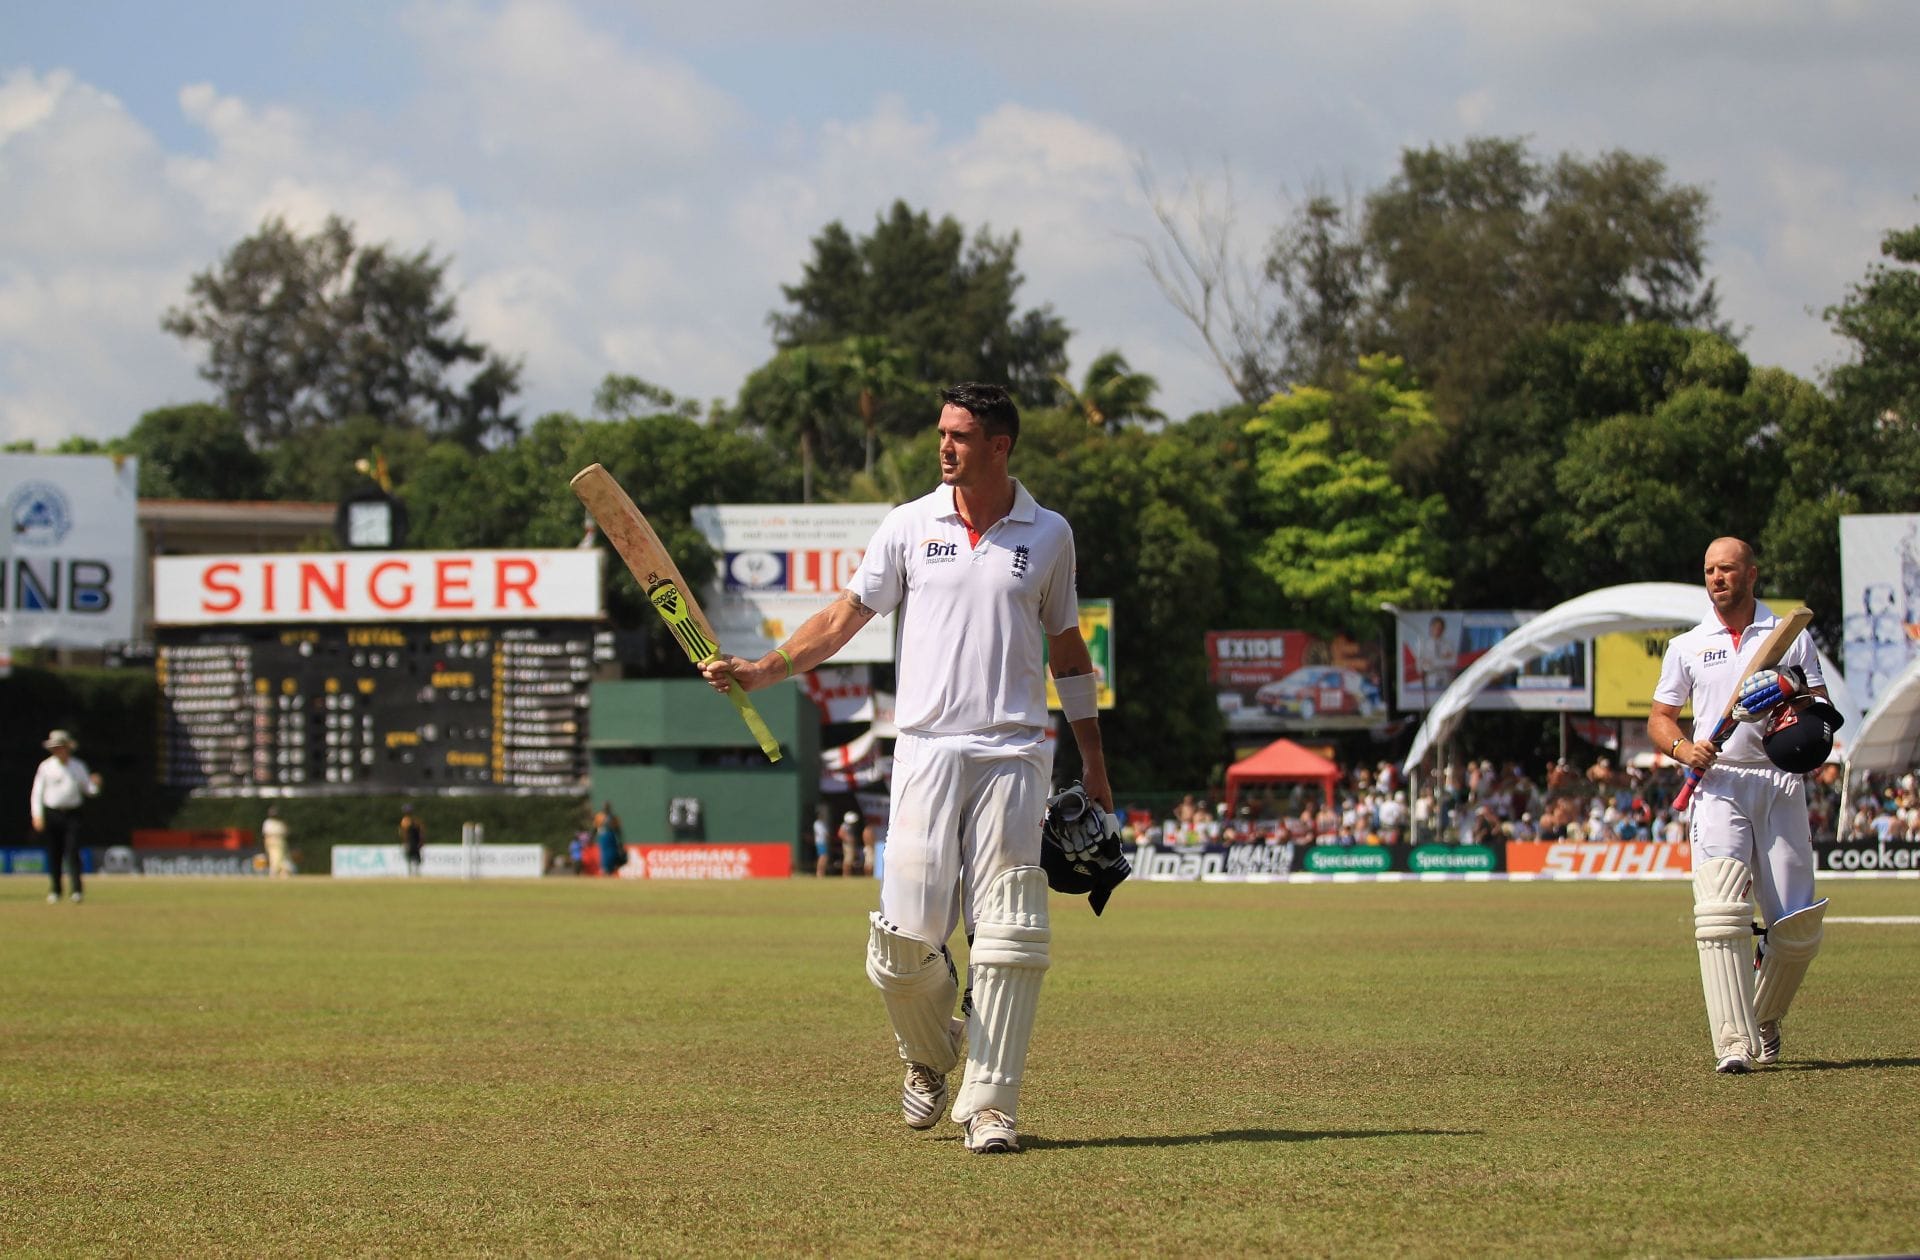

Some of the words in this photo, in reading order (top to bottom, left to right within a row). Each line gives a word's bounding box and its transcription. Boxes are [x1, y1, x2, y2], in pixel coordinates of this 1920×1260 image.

[927, 542, 958, 557] Brit
[926, 557, 956, 565] insurance
[0, 557, 112, 613] NB
[202, 558, 539, 613] SINGER
[1217, 638, 1283, 659] EXIDE
[1703, 649, 1728, 663] Brit
[1311, 852, 1384, 870] Specsavers
[1416, 851, 1488, 869] Specsavers
[1541, 843, 1684, 875] STIHL
